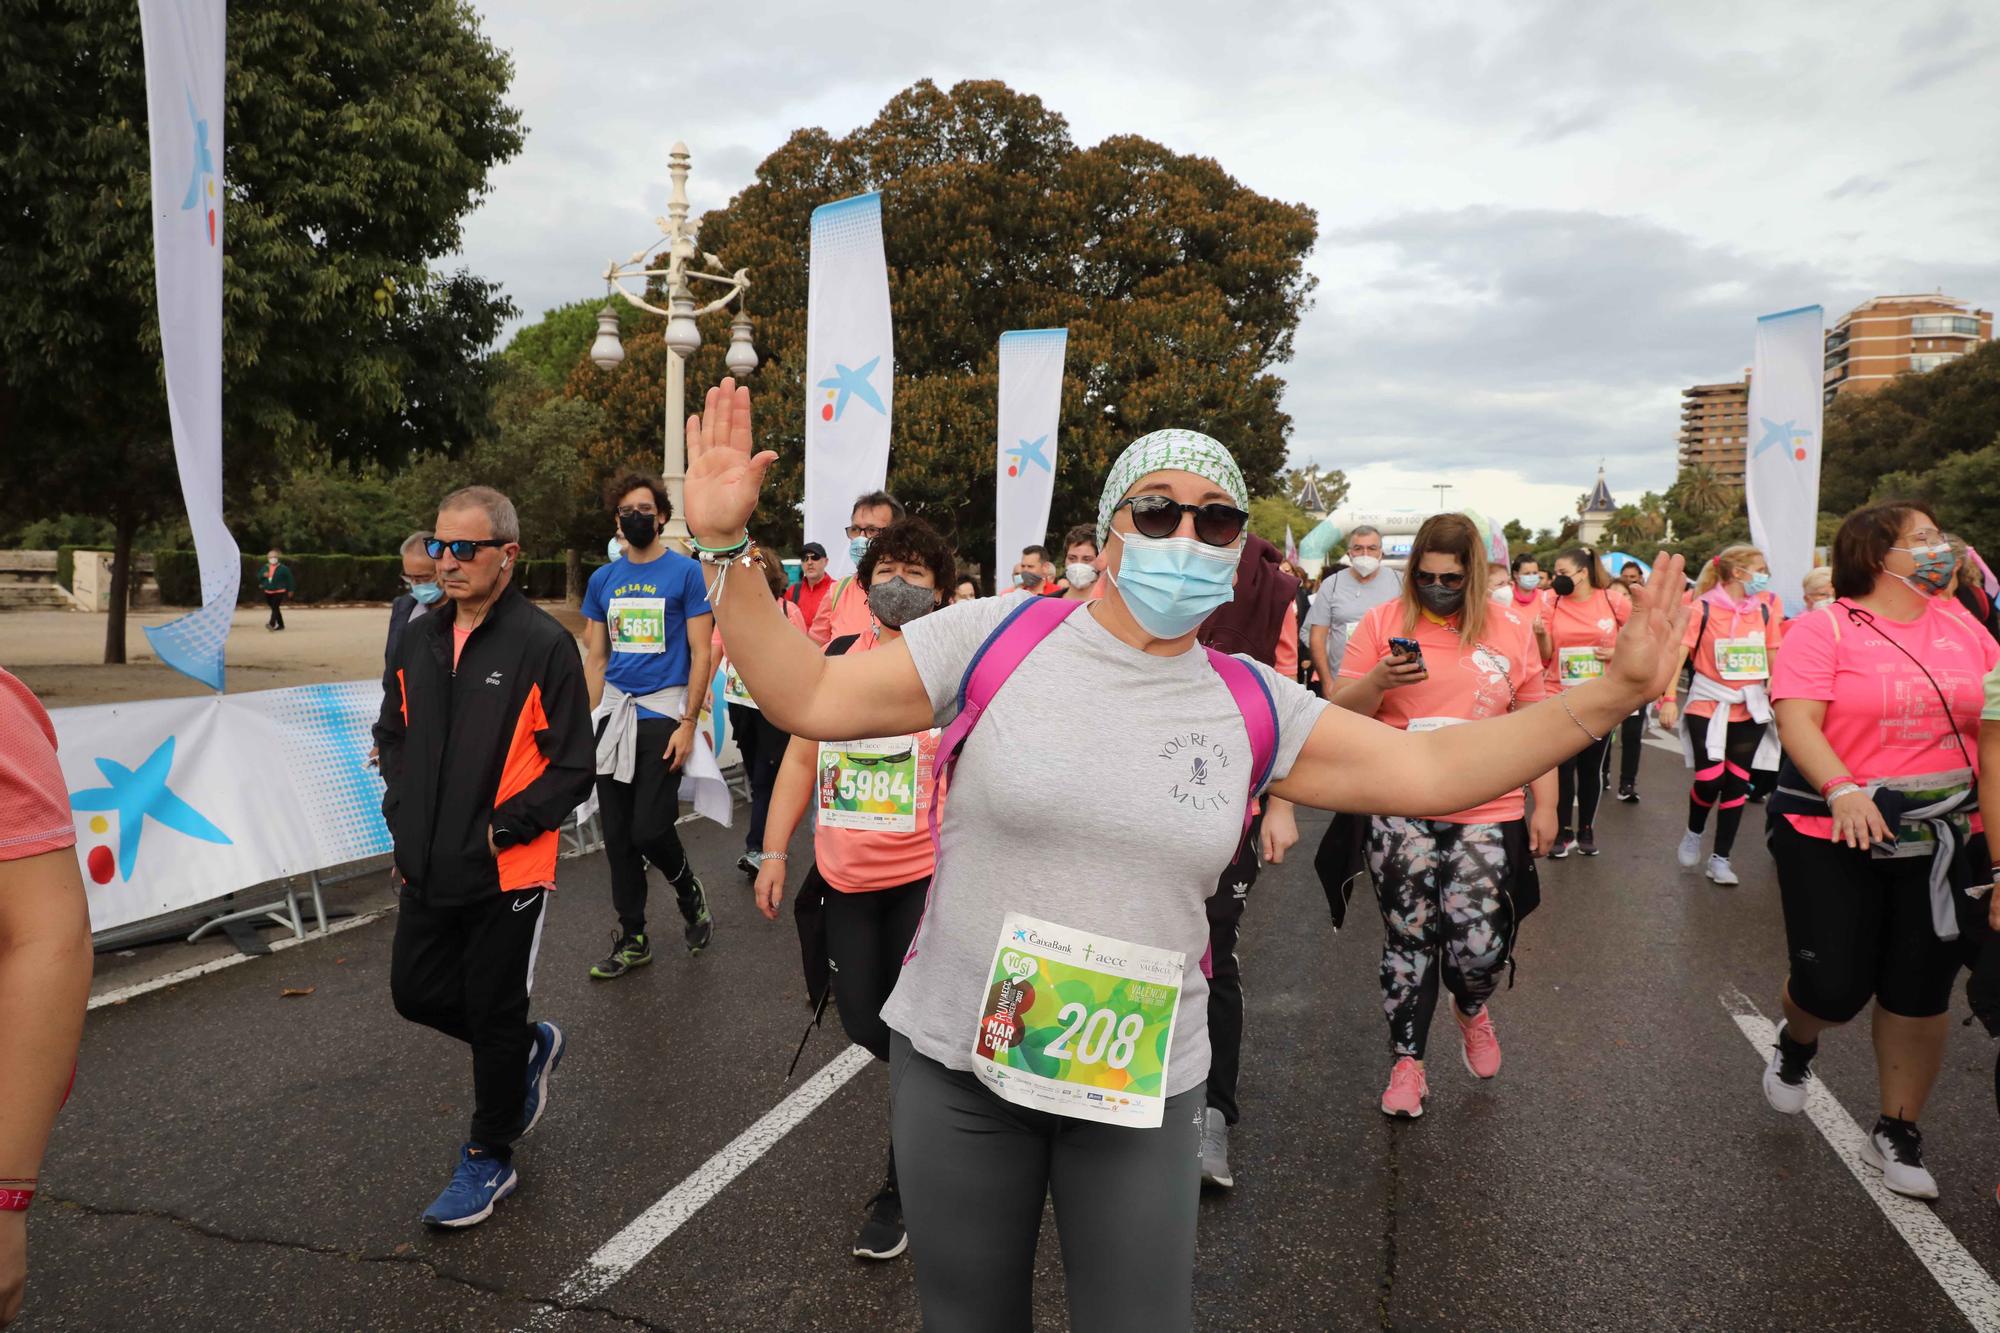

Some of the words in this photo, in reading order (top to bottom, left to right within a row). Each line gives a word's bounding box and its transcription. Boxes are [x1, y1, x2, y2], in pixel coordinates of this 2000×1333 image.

[614, 586, 627, 597] DE
[628, 584, 641, 592] LA
[623, 617, 659, 637] 5631
[1729, 653, 1763, 668] 5578
[485, 677, 501, 686] ipso
[1158, 733, 1209, 760] YOU'RE
[1212, 744, 1231, 768] ON
[840, 768, 910, 803] 5984
[1168, 784, 1231, 811] MUTE
[1029, 932, 1073, 954] CaixaBank
[1095, 953, 1128, 968] aecc
[987, 1019, 1015, 1040] MAR
[1043, 1002, 1144, 1069] 208
[984, 1034, 1009, 1054] CHA
